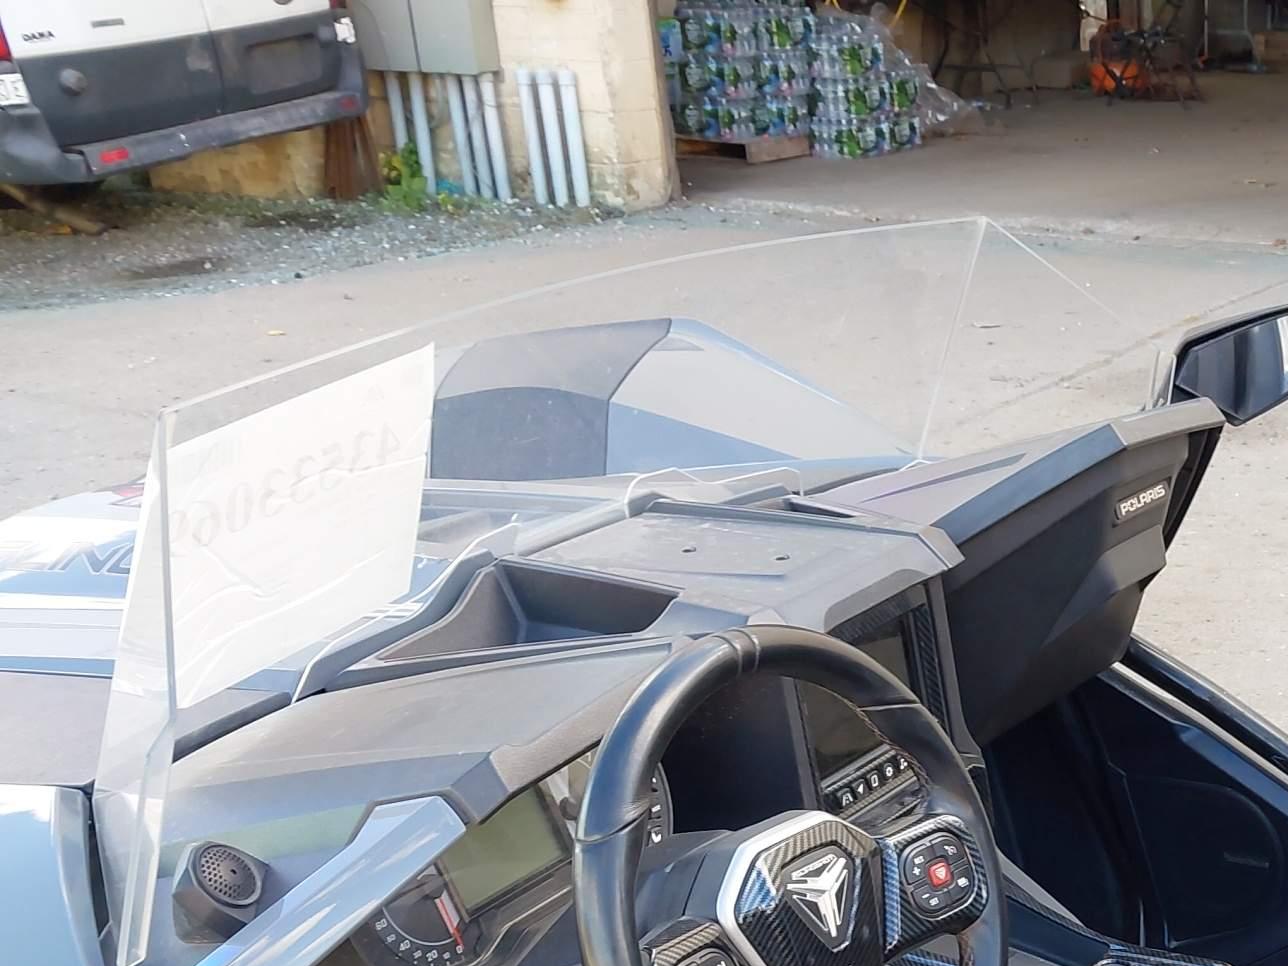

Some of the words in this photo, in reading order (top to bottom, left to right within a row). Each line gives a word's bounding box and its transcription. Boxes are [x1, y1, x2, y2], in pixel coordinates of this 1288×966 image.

[1120, 485, 1166, 516] POLARIS
[400, 940, 411, 951] 40
[426, 950, 438, 961] 20
